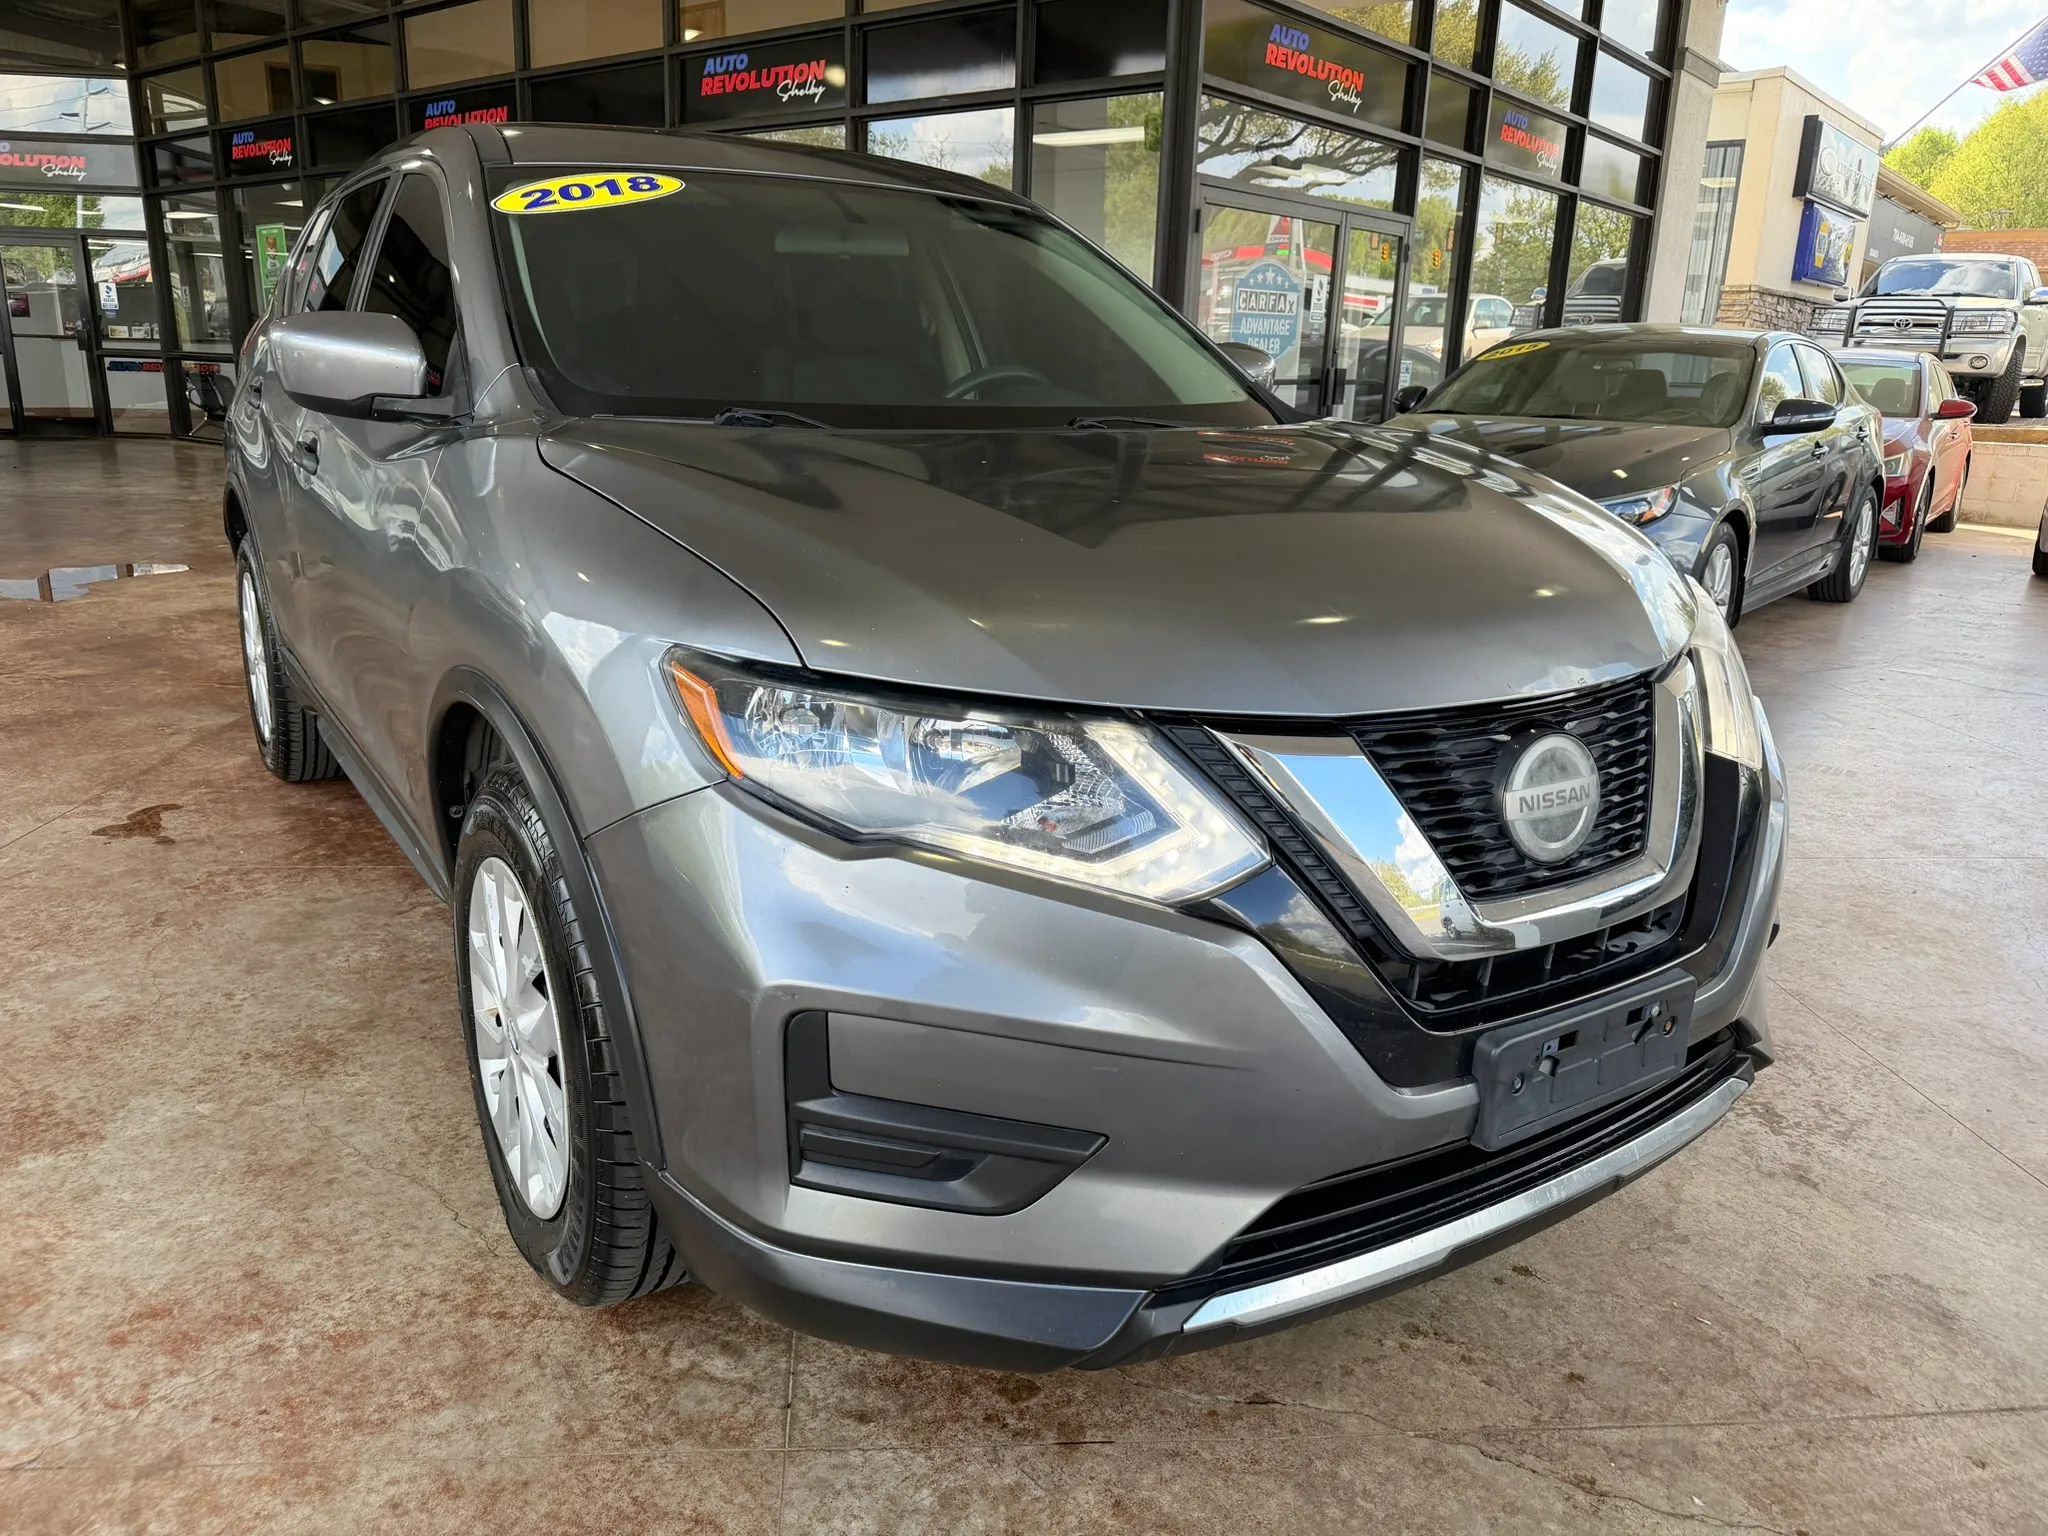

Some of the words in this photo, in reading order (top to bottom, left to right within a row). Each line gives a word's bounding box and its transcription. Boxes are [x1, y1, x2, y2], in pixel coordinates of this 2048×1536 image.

[1269, 24, 1309, 51] AUTO
[703, 53, 748, 75] AUTO
[1265, 43, 1365, 91] REVOLUTION
[701, 60, 826, 96] REVOLUTION
[776, 76, 826, 103] Shelby
[1328, 80, 1362, 113] Shelby
[425, 106, 508, 129] REVOLUTION
[426, 100, 456, 117] AUTO
[1504, 111, 1528, 129] AUTO
[232, 137, 292, 160] REVOLUTION
[233, 131, 255, 145] AUTO
[1501, 124, 1560, 159] REVOLUTION
[269, 148, 293, 167] Shelby
[41, 163, 87, 181] Shelby
[520, 176, 664, 210] 2018
[1239, 290, 1295, 314] CARFAX
[1240, 317, 1291, 335] ADVANTAGE
[1247, 337, 1281, 354] DEALER
[1519, 782, 1590, 814] NISSAN
